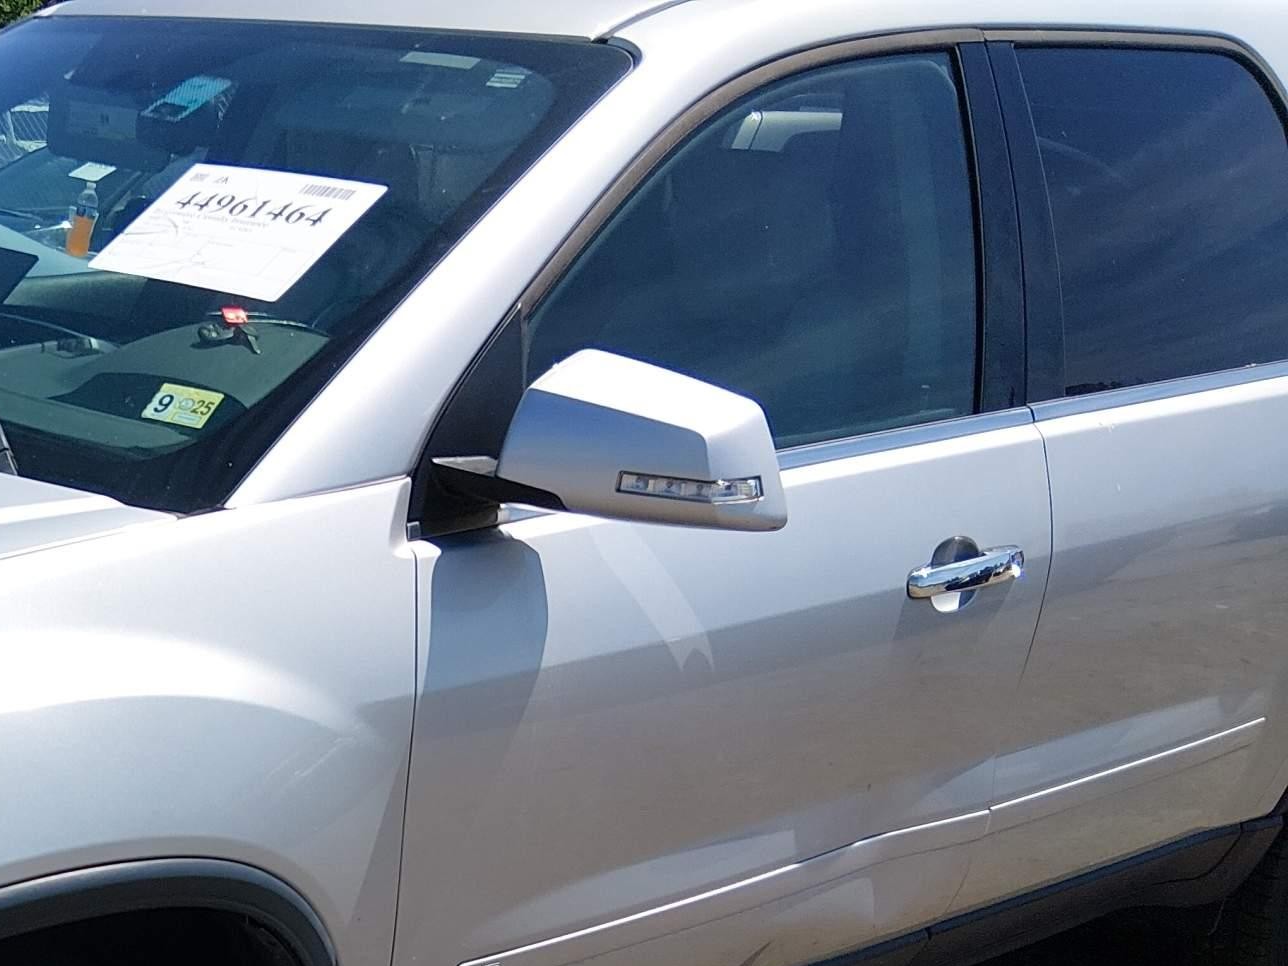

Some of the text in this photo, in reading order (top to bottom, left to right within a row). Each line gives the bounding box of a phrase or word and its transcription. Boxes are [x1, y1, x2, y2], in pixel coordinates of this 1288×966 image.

[176, 190, 333, 228] 44961464
[153, 394, 216, 415] 9 25
